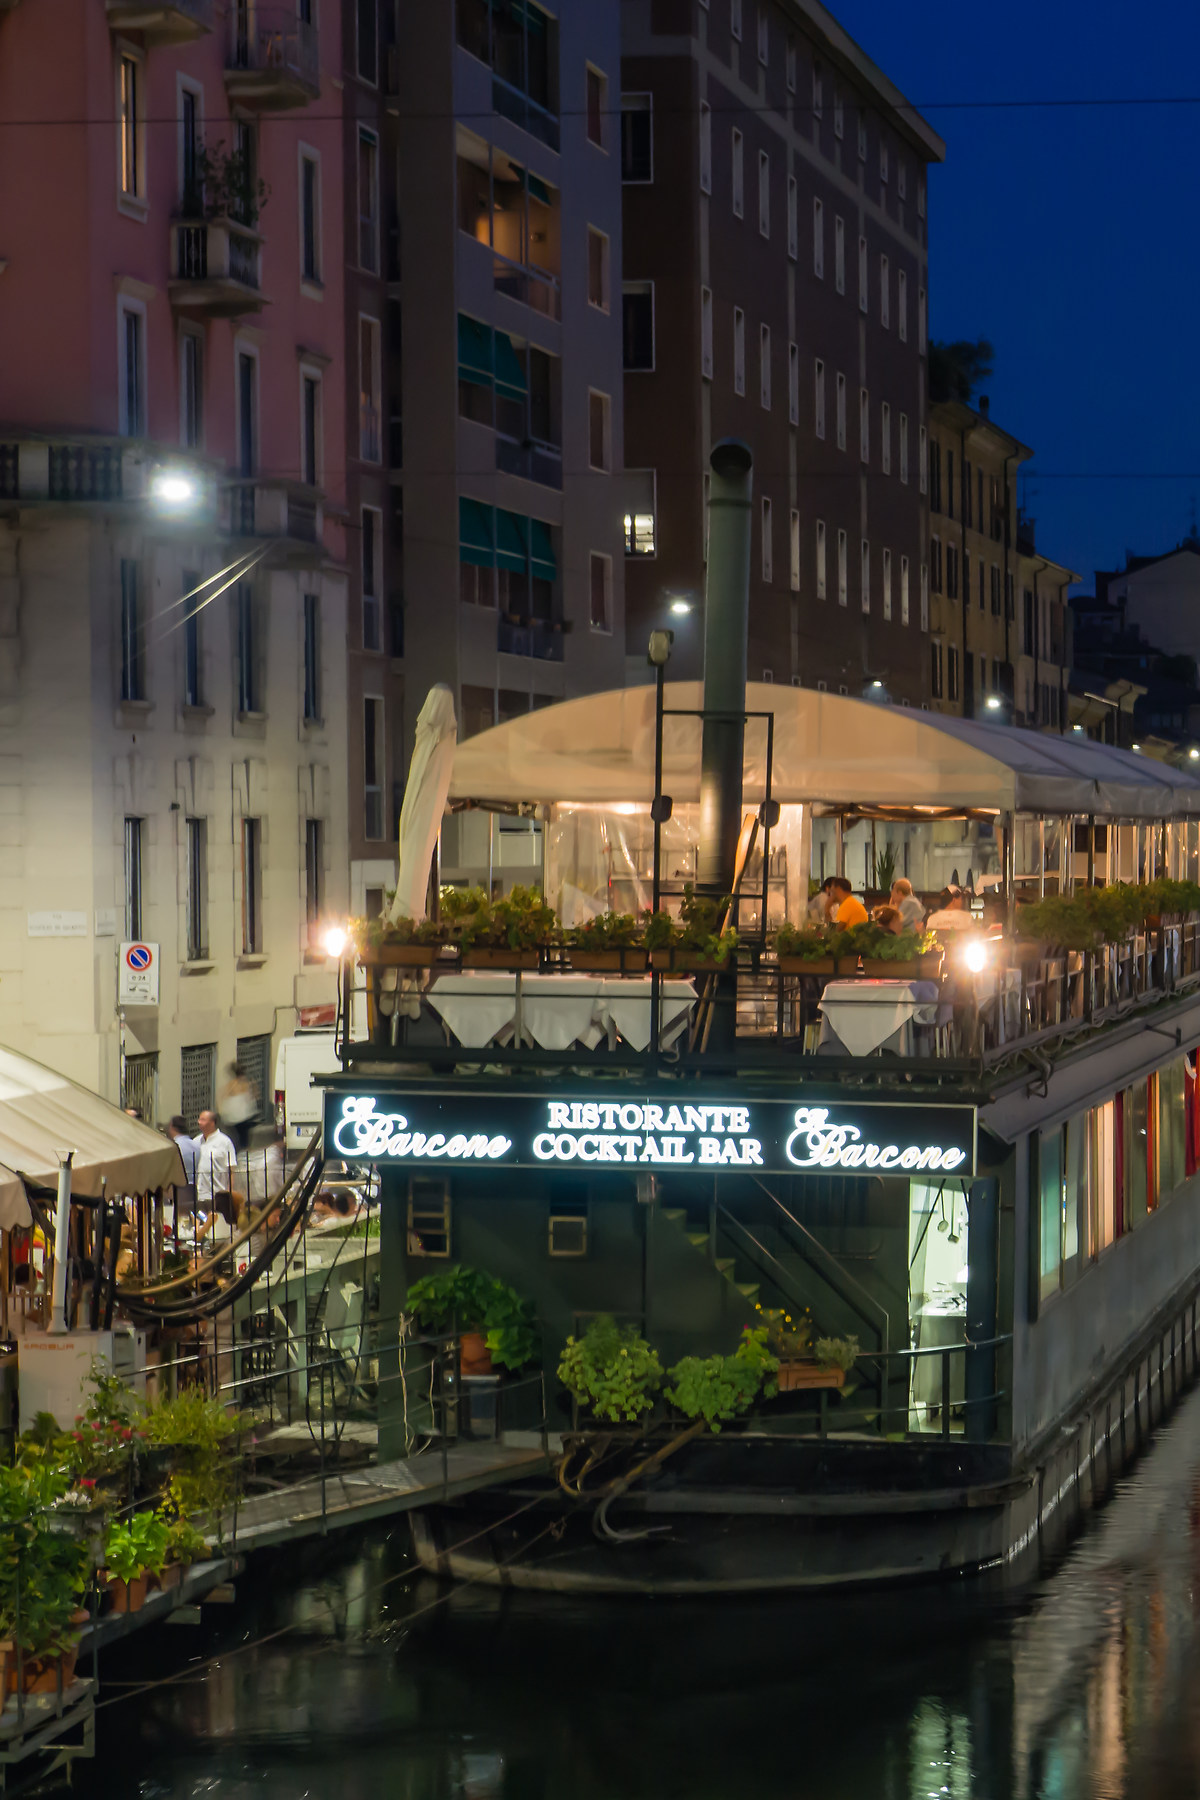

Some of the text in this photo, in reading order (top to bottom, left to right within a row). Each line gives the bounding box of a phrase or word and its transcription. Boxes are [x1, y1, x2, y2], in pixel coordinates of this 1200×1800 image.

[333, 1112, 512, 1159] Barcone
[547, 1101, 751, 1133] RISTORANTE
[532, 1133, 765, 1165] COCKTAIL BAR
[785, 1124, 966, 1170] Barcone
